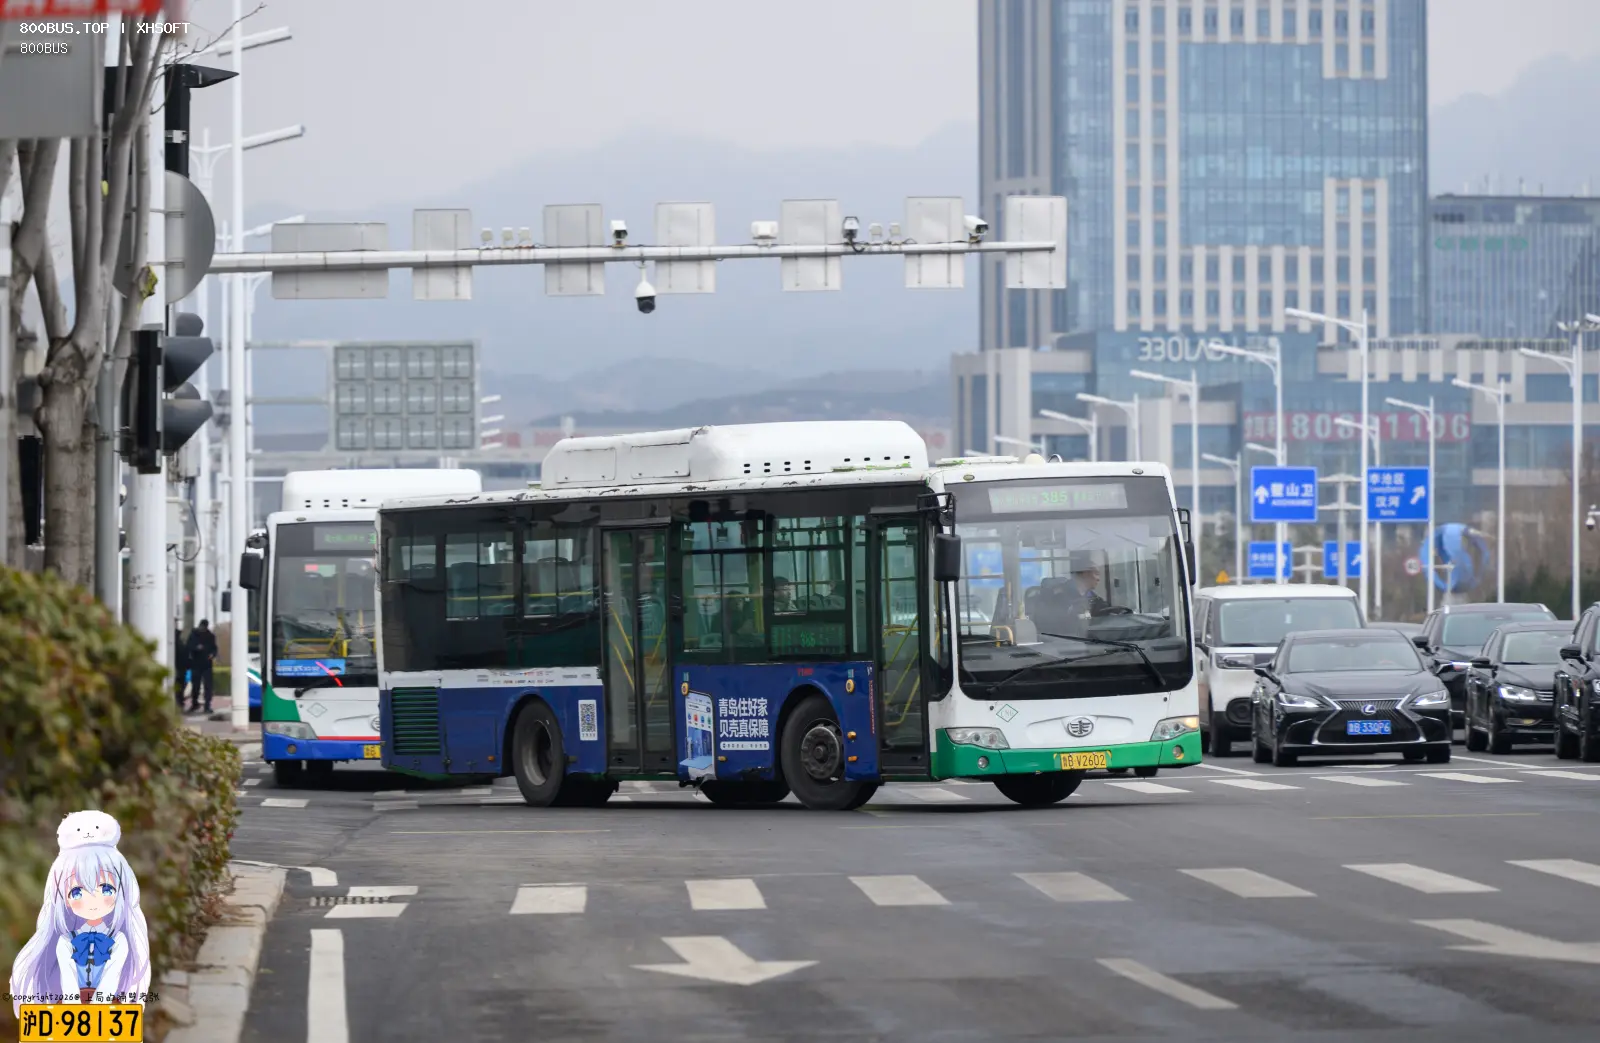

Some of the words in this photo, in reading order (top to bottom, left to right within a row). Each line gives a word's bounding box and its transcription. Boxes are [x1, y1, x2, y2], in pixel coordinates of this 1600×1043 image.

[1292, 413, 1470, 439] 8081106
[718, 697, 768, 717] 青岛住好家
[719, 718, 769, 738] 贝壳真保障
